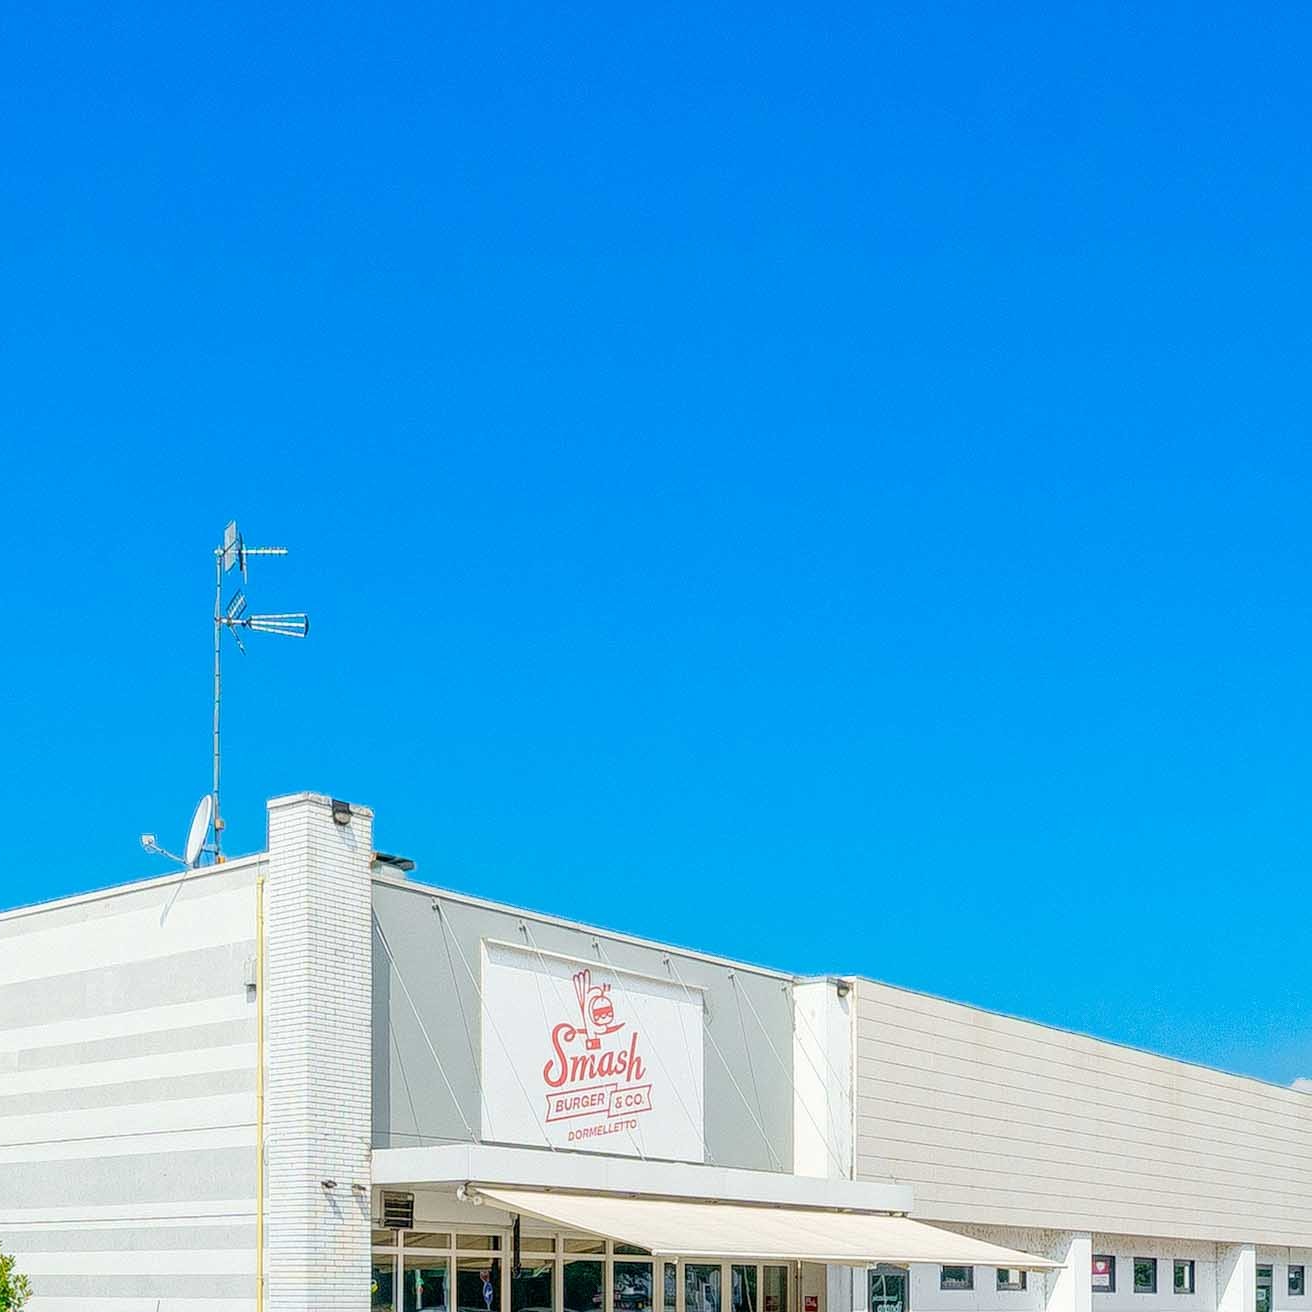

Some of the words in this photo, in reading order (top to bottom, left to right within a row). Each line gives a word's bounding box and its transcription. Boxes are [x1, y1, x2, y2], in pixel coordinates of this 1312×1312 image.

[543, 1022, 646, 1088] Smash
[555, 1092, 605, 1113] BURGER
[614, 1096, 623, 1109] &
[624, 1093, 645, 1107] CO.
[568, 1119, 637, 1141] DORMELLETTO
